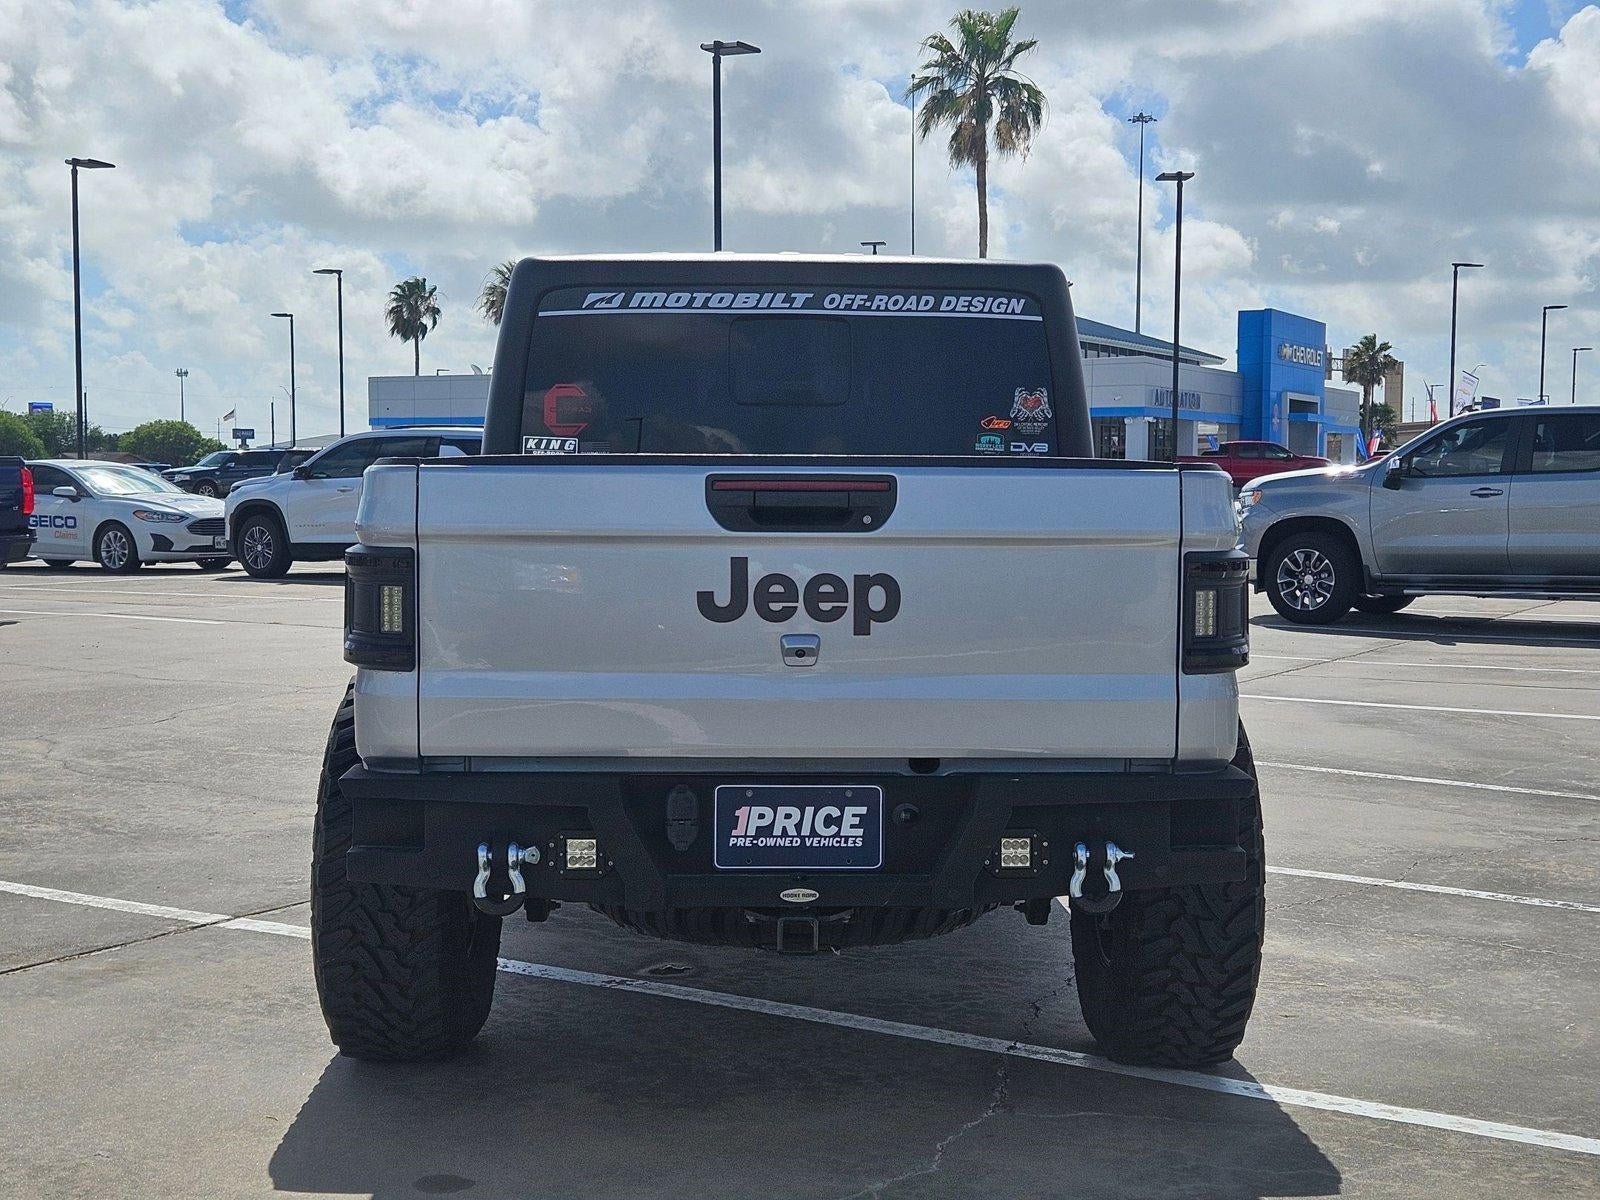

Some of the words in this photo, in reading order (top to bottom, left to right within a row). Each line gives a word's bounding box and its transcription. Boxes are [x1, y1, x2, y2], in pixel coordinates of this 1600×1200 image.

[628, 292, 814, 308] MOTOBILT
[823, 293, 936, 311] OFF-ROAD
[939, 296, 1026, 314] DESIGN
[1293, 345, 1324, 367] CHEVROLET
[1154, 388, 1201, 409] AUTOATION
[526, 439, 576, 451] KING
[29, 515, 77, 529] GEICO
[53, 530, 78, 540] Claims
[697, 557, 901, 636] Jeep
[731, 806, 868, 837] 1PRICE
[729, 837, 801, 847] PRE-OWNED
[805, 837, 863, 848] VEHICLES
